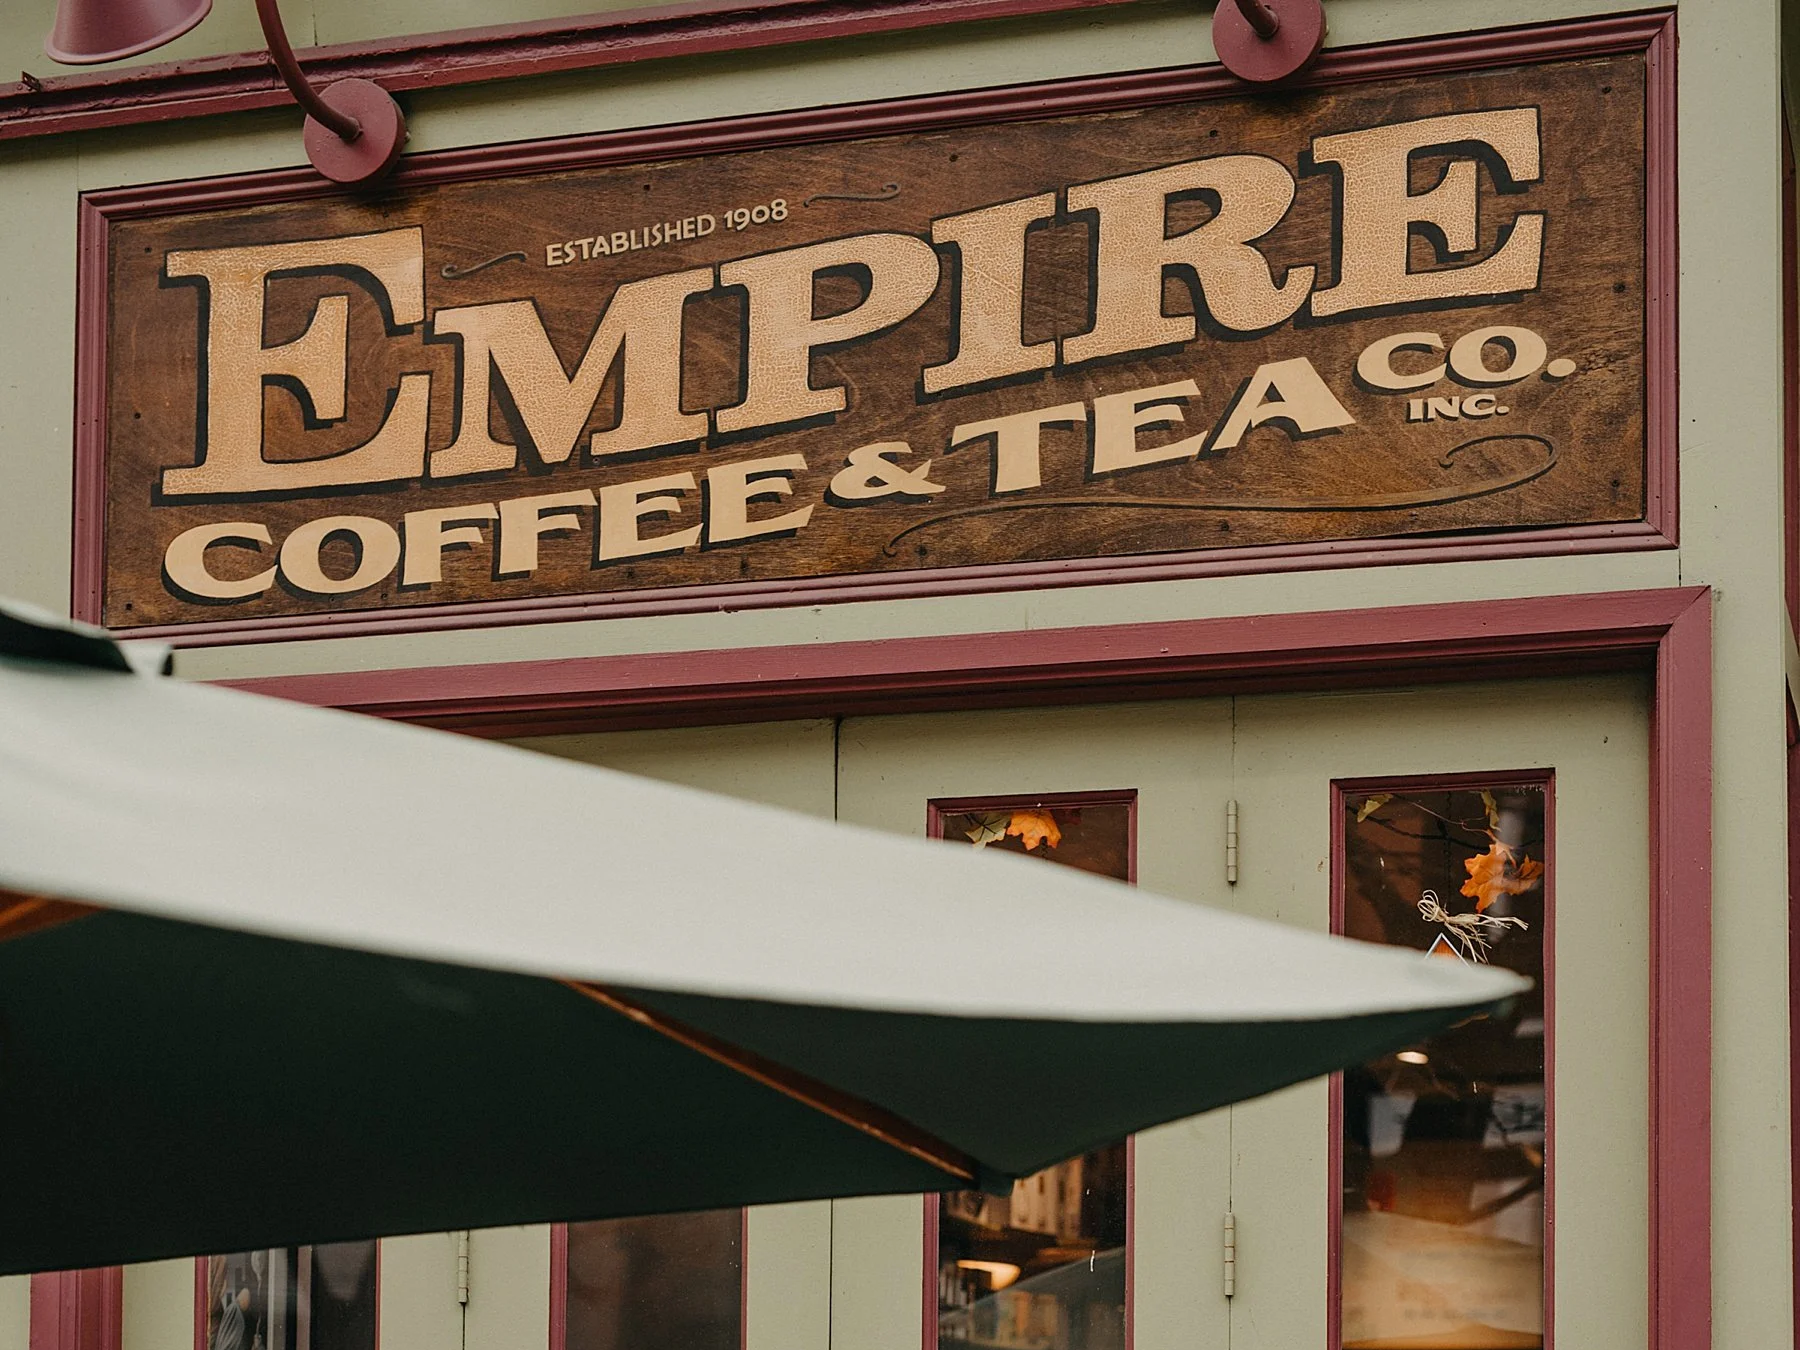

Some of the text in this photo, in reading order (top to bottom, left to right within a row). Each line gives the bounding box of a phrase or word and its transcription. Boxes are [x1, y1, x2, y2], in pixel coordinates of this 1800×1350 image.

[162, 106, 1543, 495] EMPIRE
[545, 198, 789, 267] ESTABLISHED 1908
[163, 325, 1577, 599] COFFEE & TEA CO.
[1408, 393, 1510, 422] INC.
